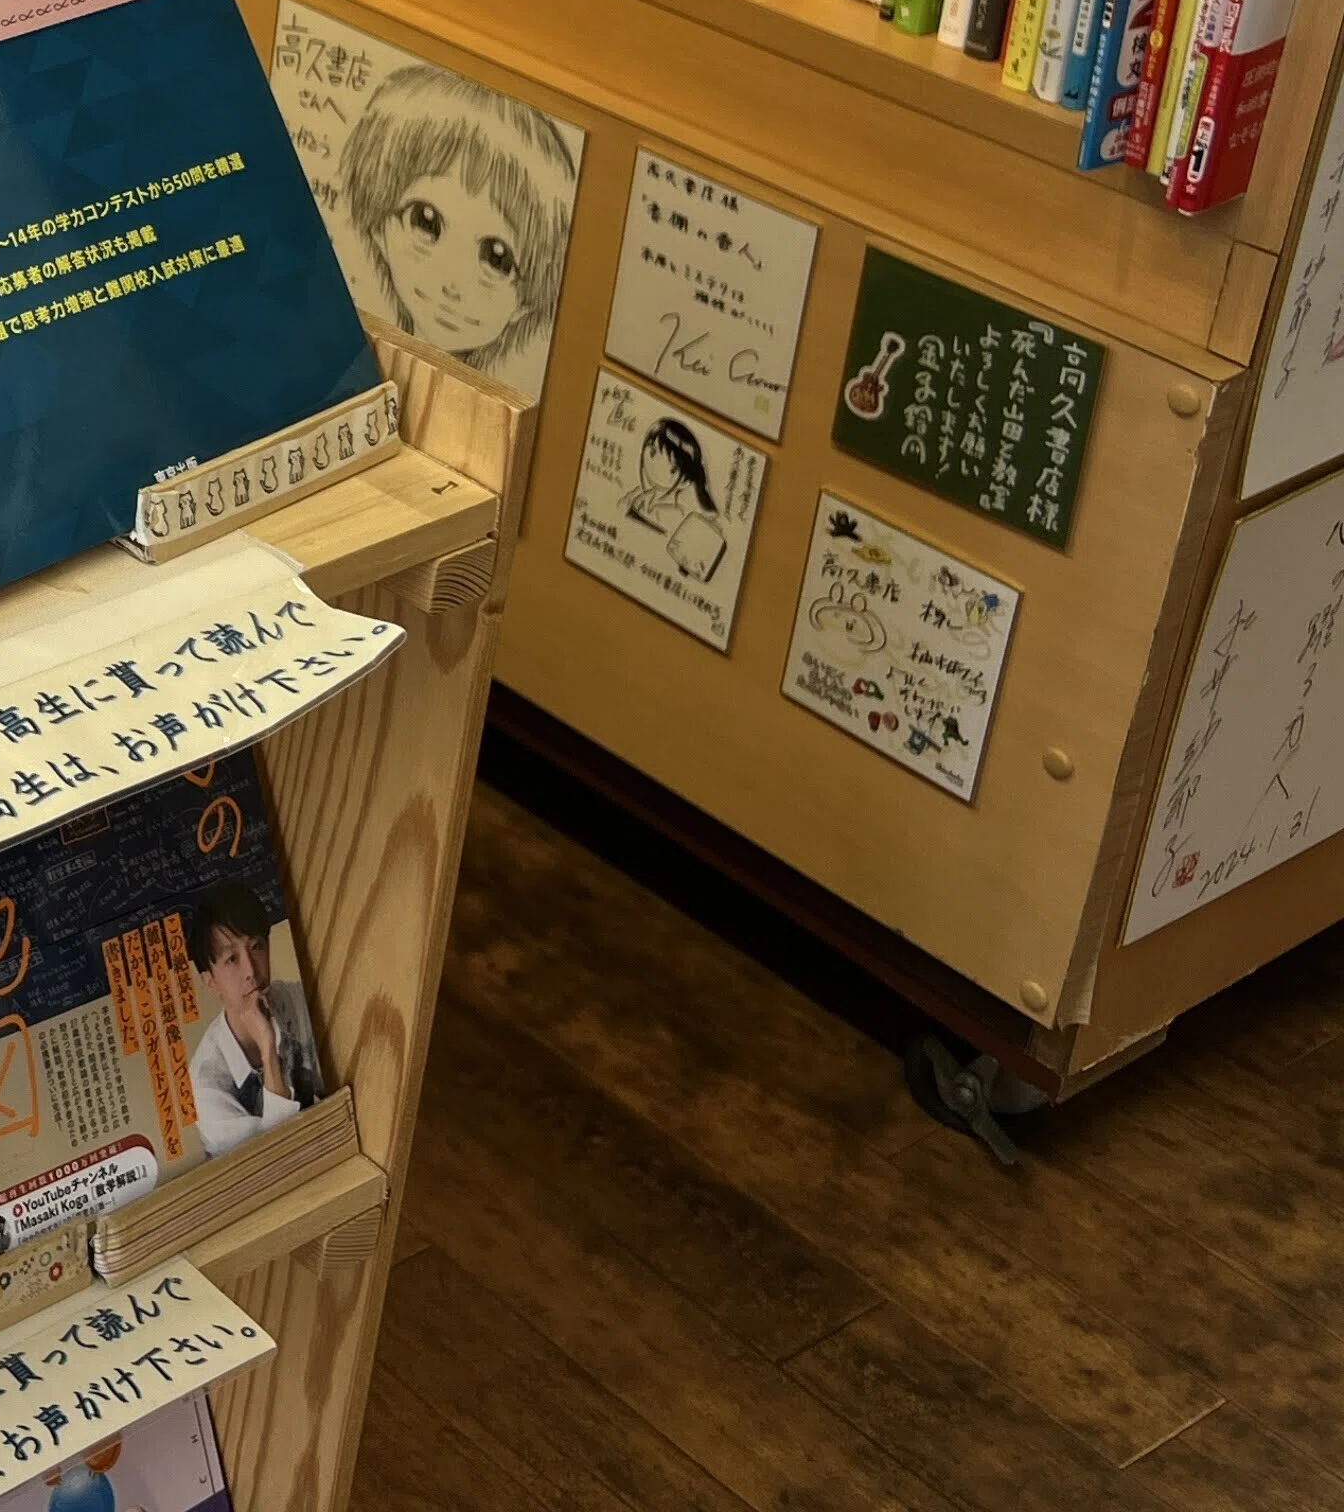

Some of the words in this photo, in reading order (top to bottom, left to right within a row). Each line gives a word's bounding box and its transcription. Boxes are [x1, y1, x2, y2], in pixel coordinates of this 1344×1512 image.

[275, 12, 373, 93] 高久書店
[1026, 341, 1090, 532] 高久書店様
